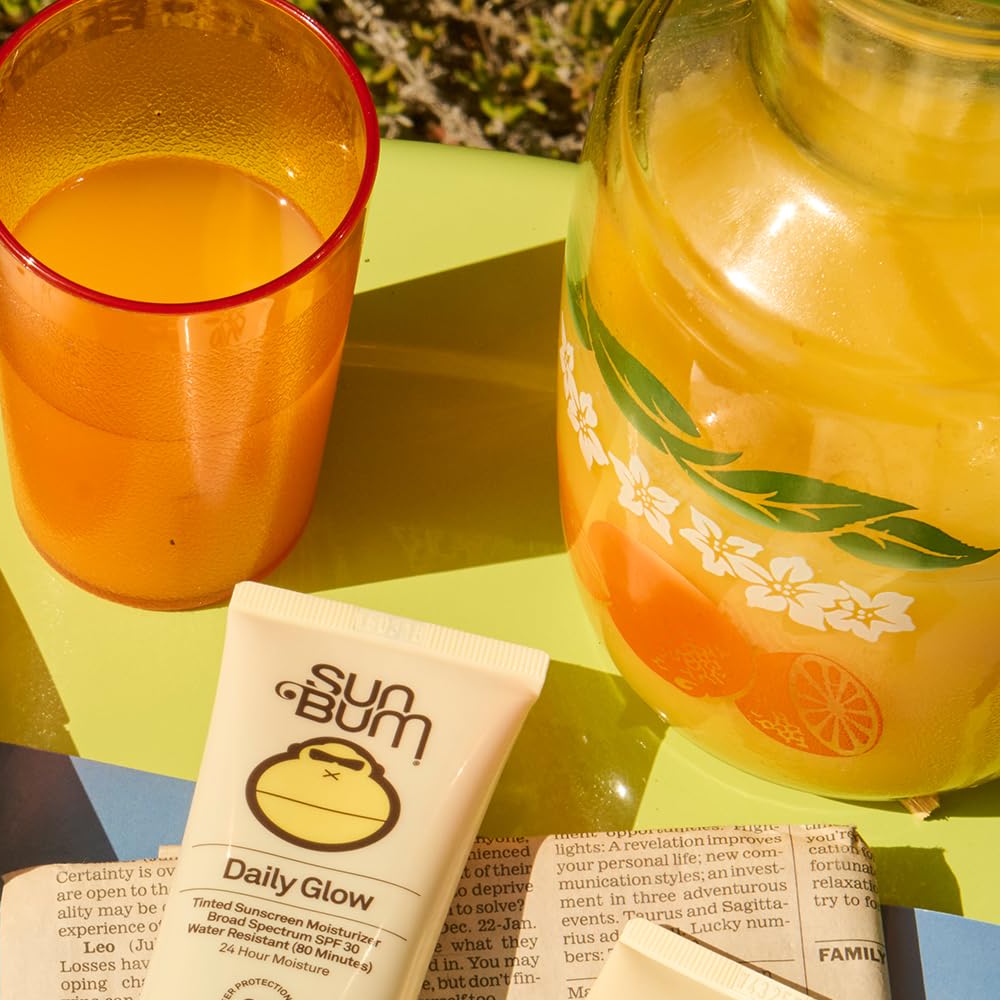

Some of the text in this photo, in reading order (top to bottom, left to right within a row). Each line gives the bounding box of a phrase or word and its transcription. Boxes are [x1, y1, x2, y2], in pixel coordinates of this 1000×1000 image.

[555, 833, 782, 856] lights: A revelation improves
[56, 865, 152, 883] Certainty is
[223, 858, 374, 911] Daily Glow
[193, 897, 381, 948] Tinted Sunscreen Moisturizer
[208, 911, 360, 954] Broad Spectrum SPF 30
[84, 942, 115, 954] Leo
[188, 923, 373, 974] Water Resistant (80 Minutes)
[219, 942, 330, 976] 24 Hour Moisture
[235, 978, 292, 1000] PROTECTION
